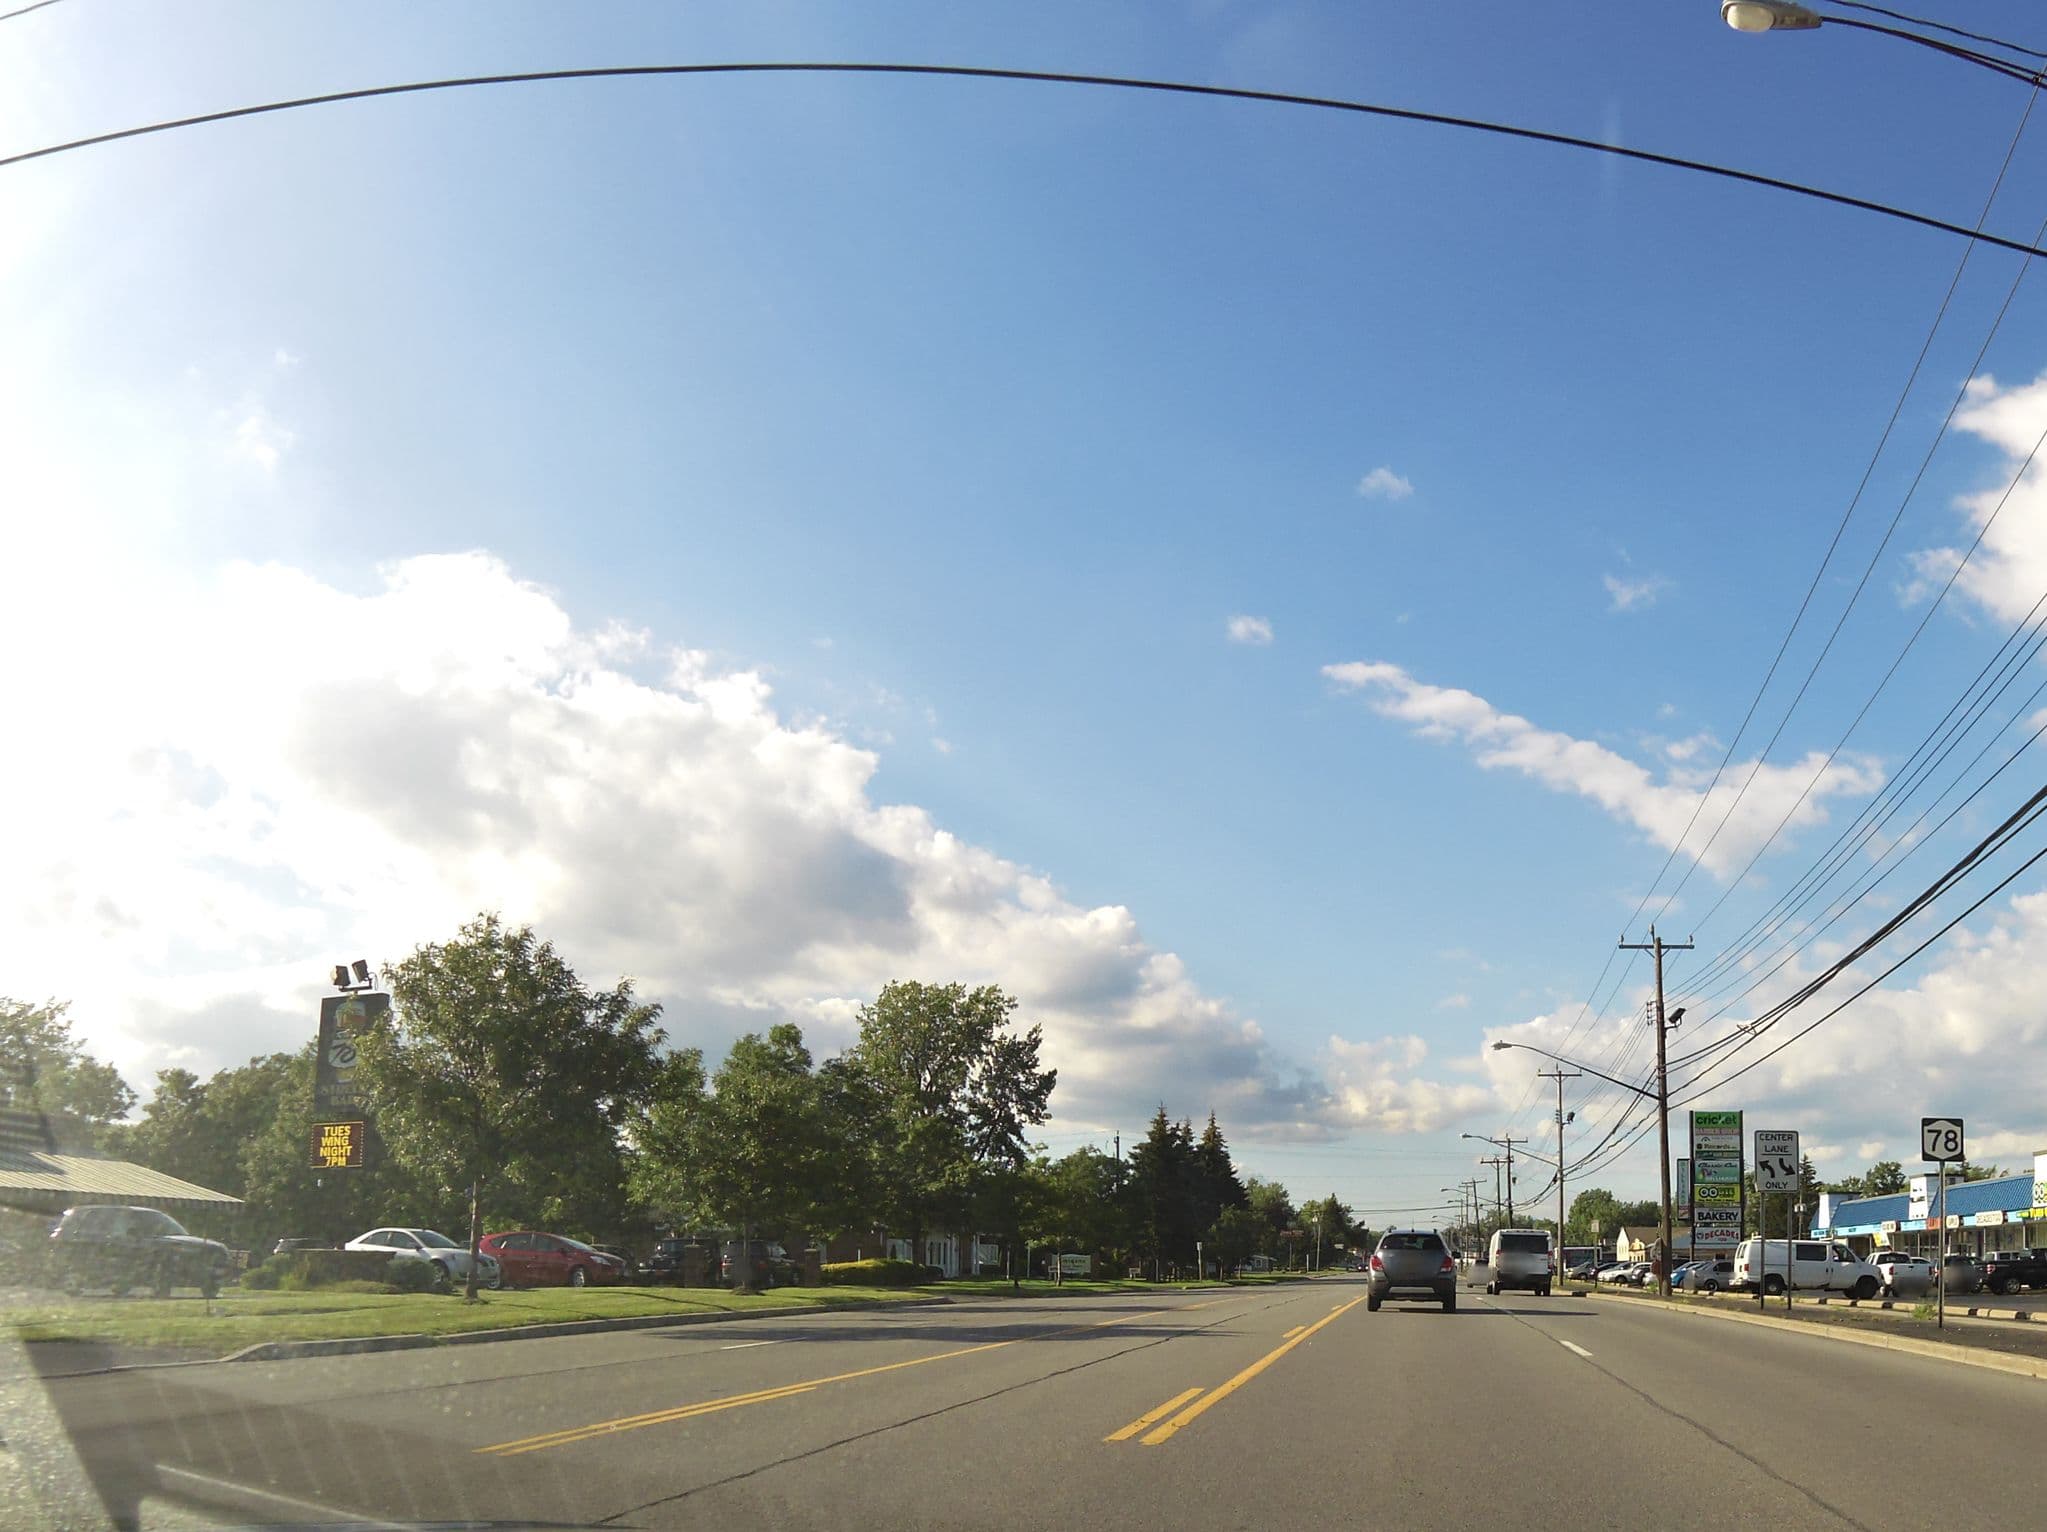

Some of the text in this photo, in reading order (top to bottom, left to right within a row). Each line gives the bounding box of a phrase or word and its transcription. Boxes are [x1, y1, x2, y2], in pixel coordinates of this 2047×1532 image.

[1696, 1114, 1737, 1125] cricket
[323, 1125, 351, 1137] TUES
[321, 1136, 349, 1147] WING
[1759, 1133, 1793, 1141] CENTER
[1927, 1129, 1959, 1152] 78
[319, 1145, 353, 1157] NIGHT
[1764, 1145, 1789, 1153] LANE
[325, 1156, 347, 1167] 7PM
[1765, 1181, 1788, 1190] ONLY
[1697, 1211, 1739, 1221] BAKERY
